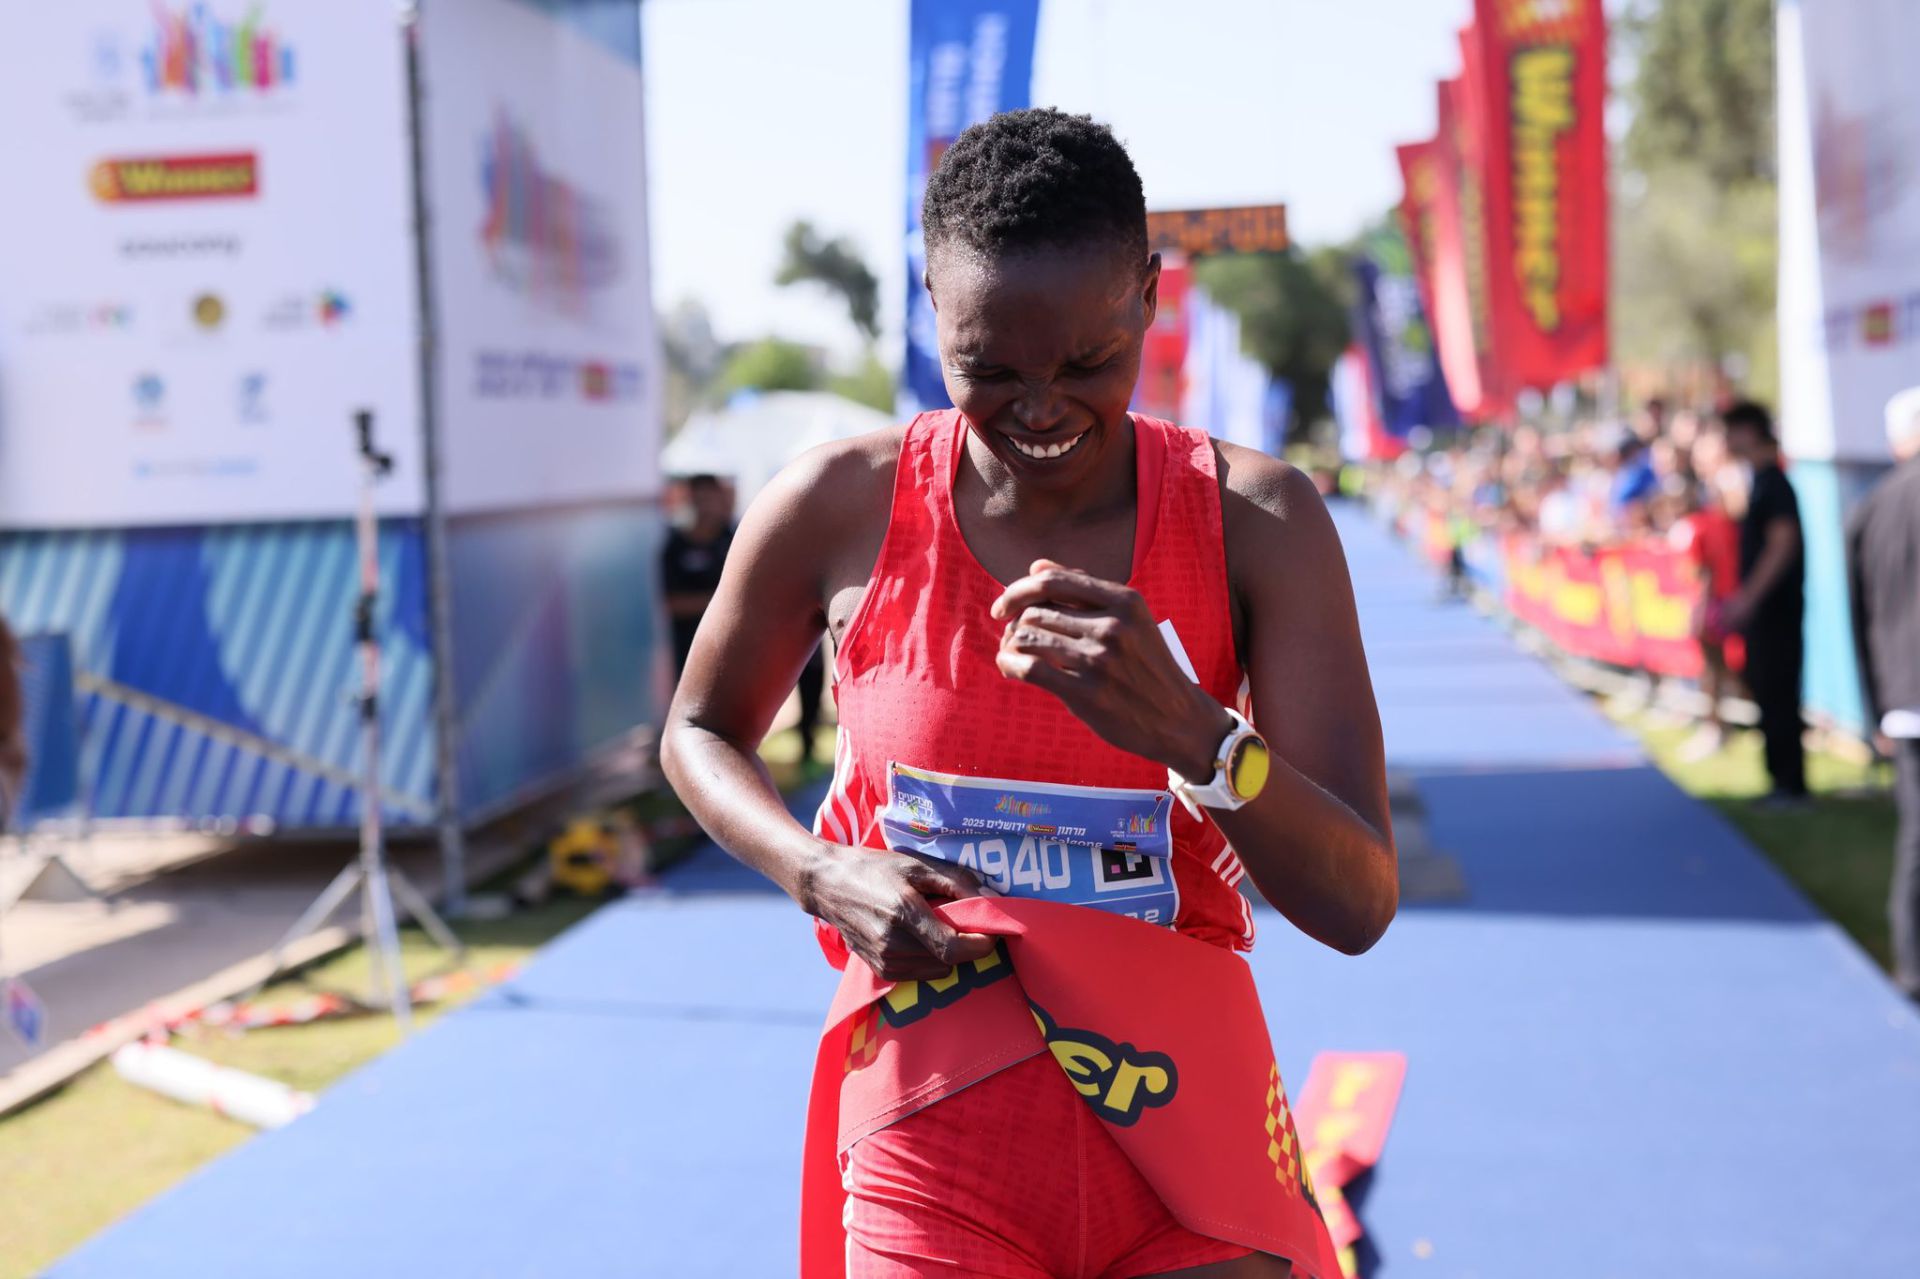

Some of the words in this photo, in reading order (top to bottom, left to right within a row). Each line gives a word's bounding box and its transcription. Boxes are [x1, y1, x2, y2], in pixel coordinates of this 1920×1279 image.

[962, 817, 985, 828] 2025
[986, 819, 1026, 831] ירושלים
[1056, 826, 1087, 836] מרתון
